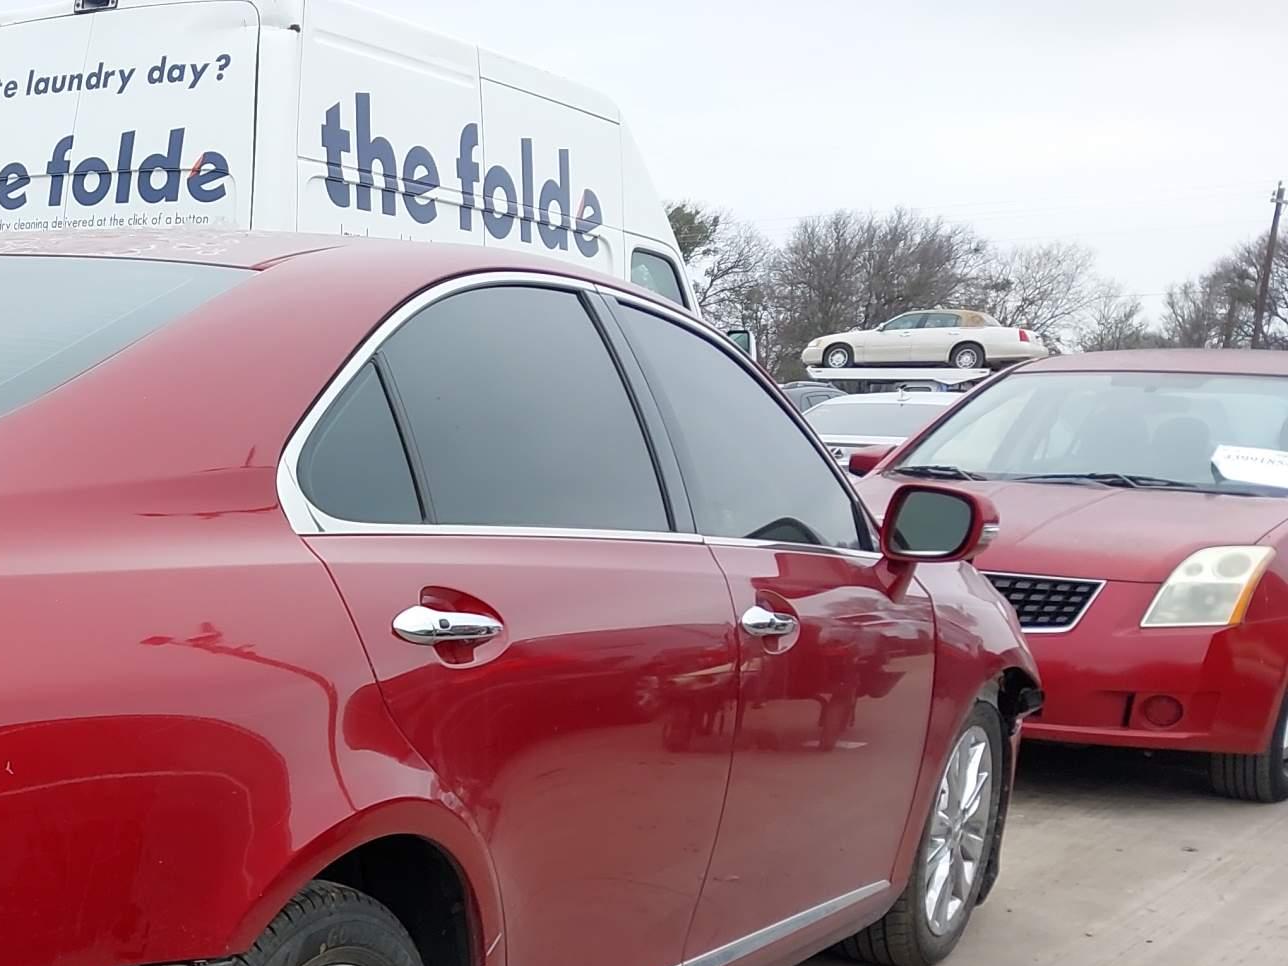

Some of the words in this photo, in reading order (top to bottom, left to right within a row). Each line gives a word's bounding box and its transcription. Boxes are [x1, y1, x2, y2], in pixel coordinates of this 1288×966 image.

[26, 62, 136, 95] laundry
[147, 54, 232, 89] day?
[46, 128, 229, 206] folde
[321, 92, 440, 224] the
[456, 122, 602, 258] folde
[13, 217, 49, 232] cleaning
[51, 215, 95, 229] delivered
[96, 215, 107, 227] at
[109, 212, 125, 226] the
[127, 212, 148, 226] click
[151, 212, 164, 225] of
[165, 217, 173, 225] a
[174, 211, 209, 225] button
